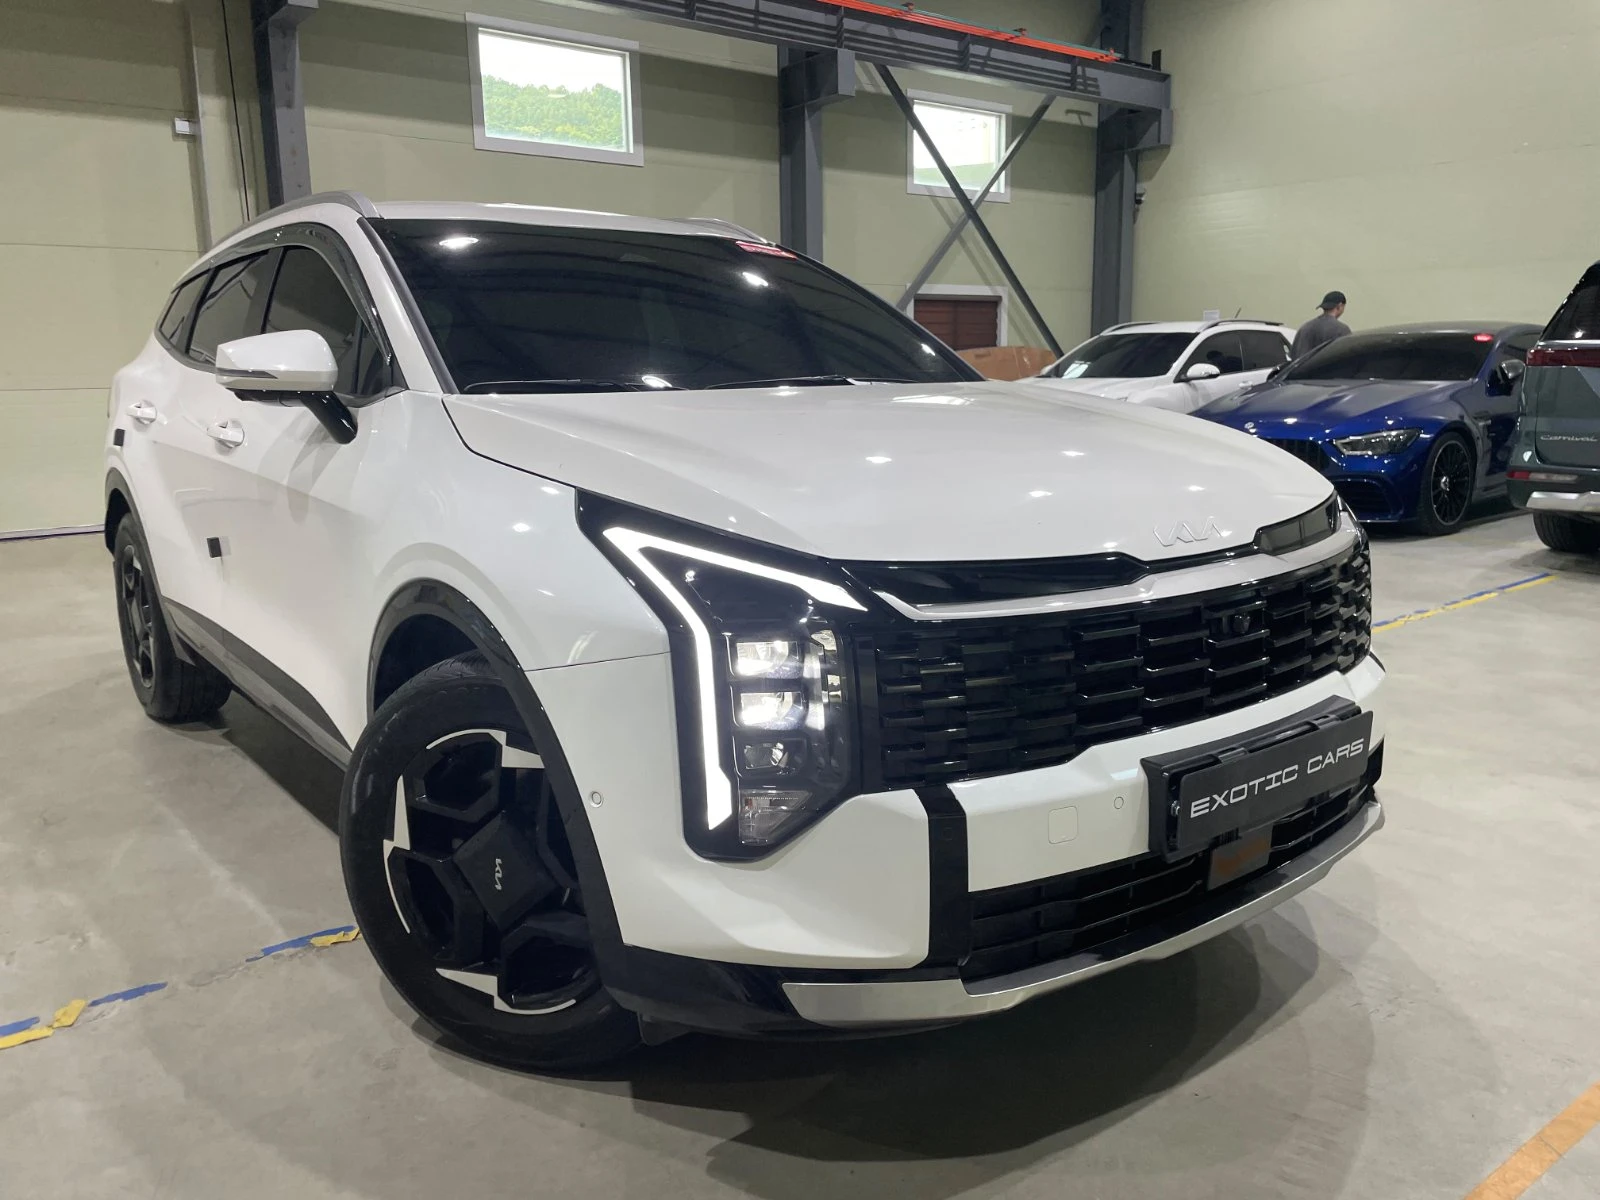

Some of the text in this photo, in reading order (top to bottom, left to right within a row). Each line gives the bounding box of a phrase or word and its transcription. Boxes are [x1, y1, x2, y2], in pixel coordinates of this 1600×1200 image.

[1152, 516, 1233, 548] KIA
[1190, 738, 1364, 818] EXOTIC CARS
[494, 858, 503, 891] KIA
